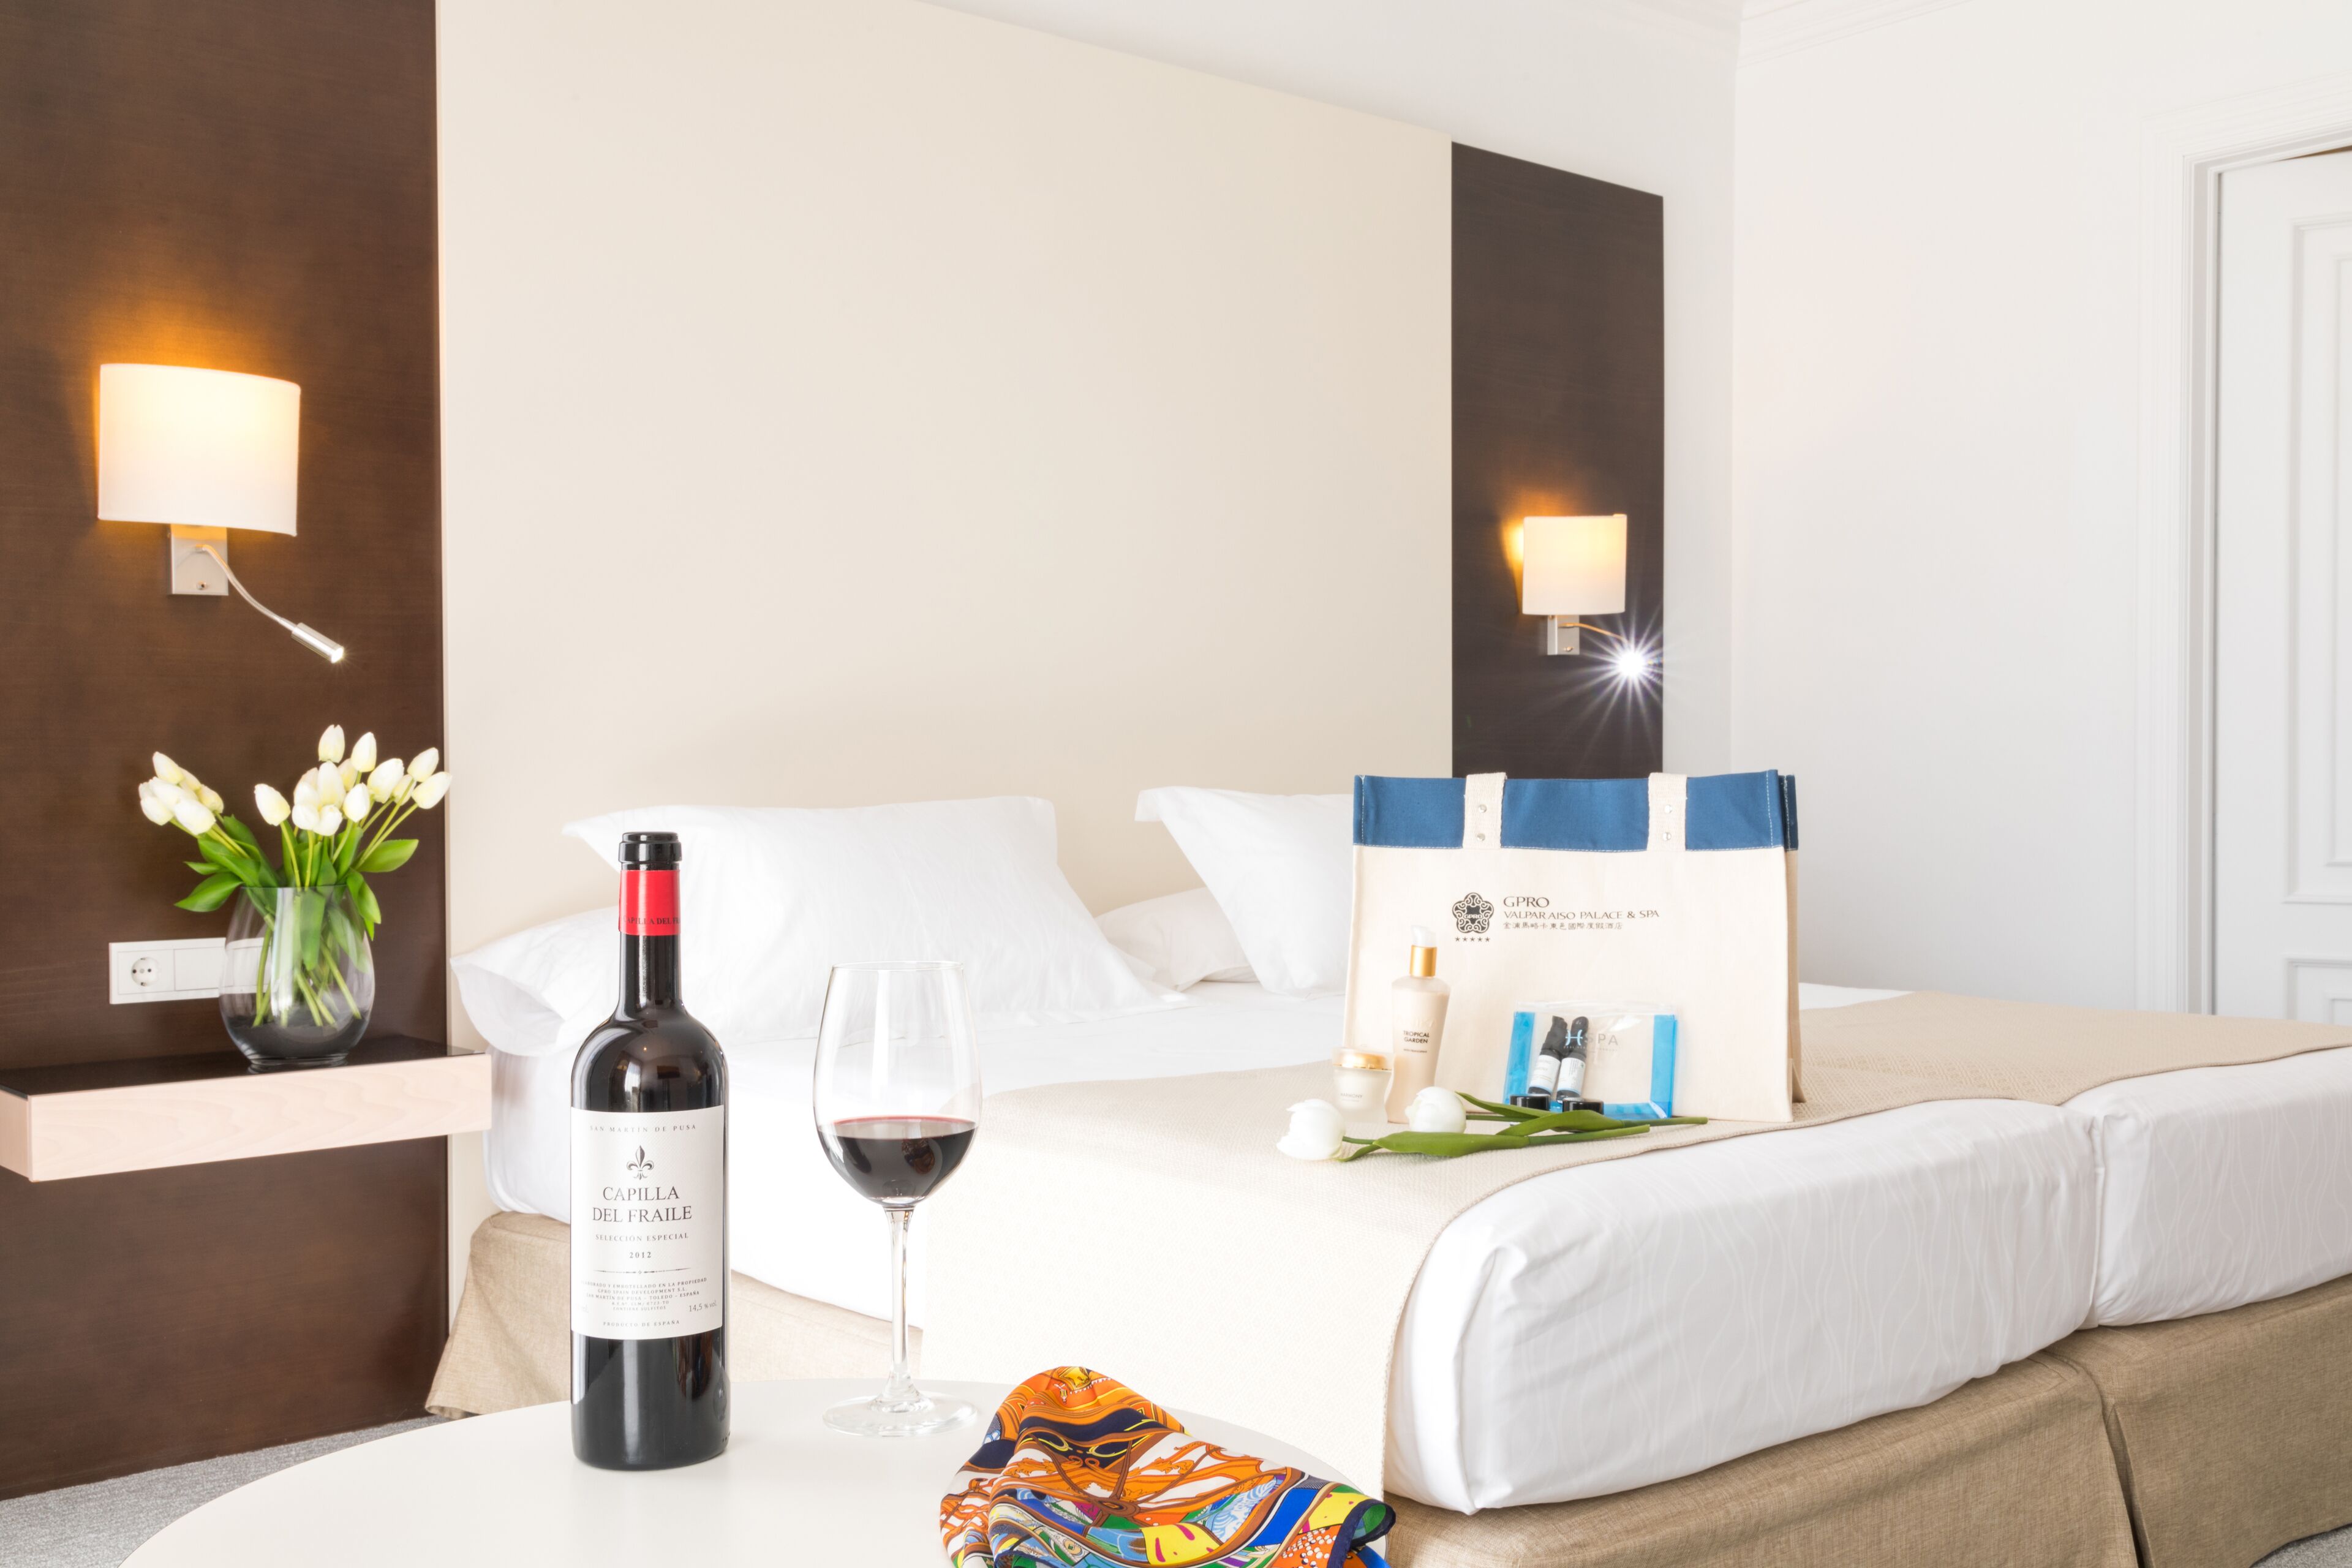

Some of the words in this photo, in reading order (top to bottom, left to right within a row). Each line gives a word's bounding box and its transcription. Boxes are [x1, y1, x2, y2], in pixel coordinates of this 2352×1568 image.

[1504, 896, 1550, 908] GPRO
[1504, 911, 1575, 920] VALPARAISO
[1580, 911, 1623, 919] PALACE
[1639, 910, 1660, 919] SPA
[624, 916, 655, 925] CAPILLA
[603, 1186, 680, 1200] CAPILLA
[592, 1207, 623, 1223] DEL
[628, 1205, 692, 1223] FRAILE
[647, 1232, 689, 1242] ESPECIAL
[677, 1277, 707, 1286] PROPIEDAD
[689, 1303, 703, 1312] 14,5
